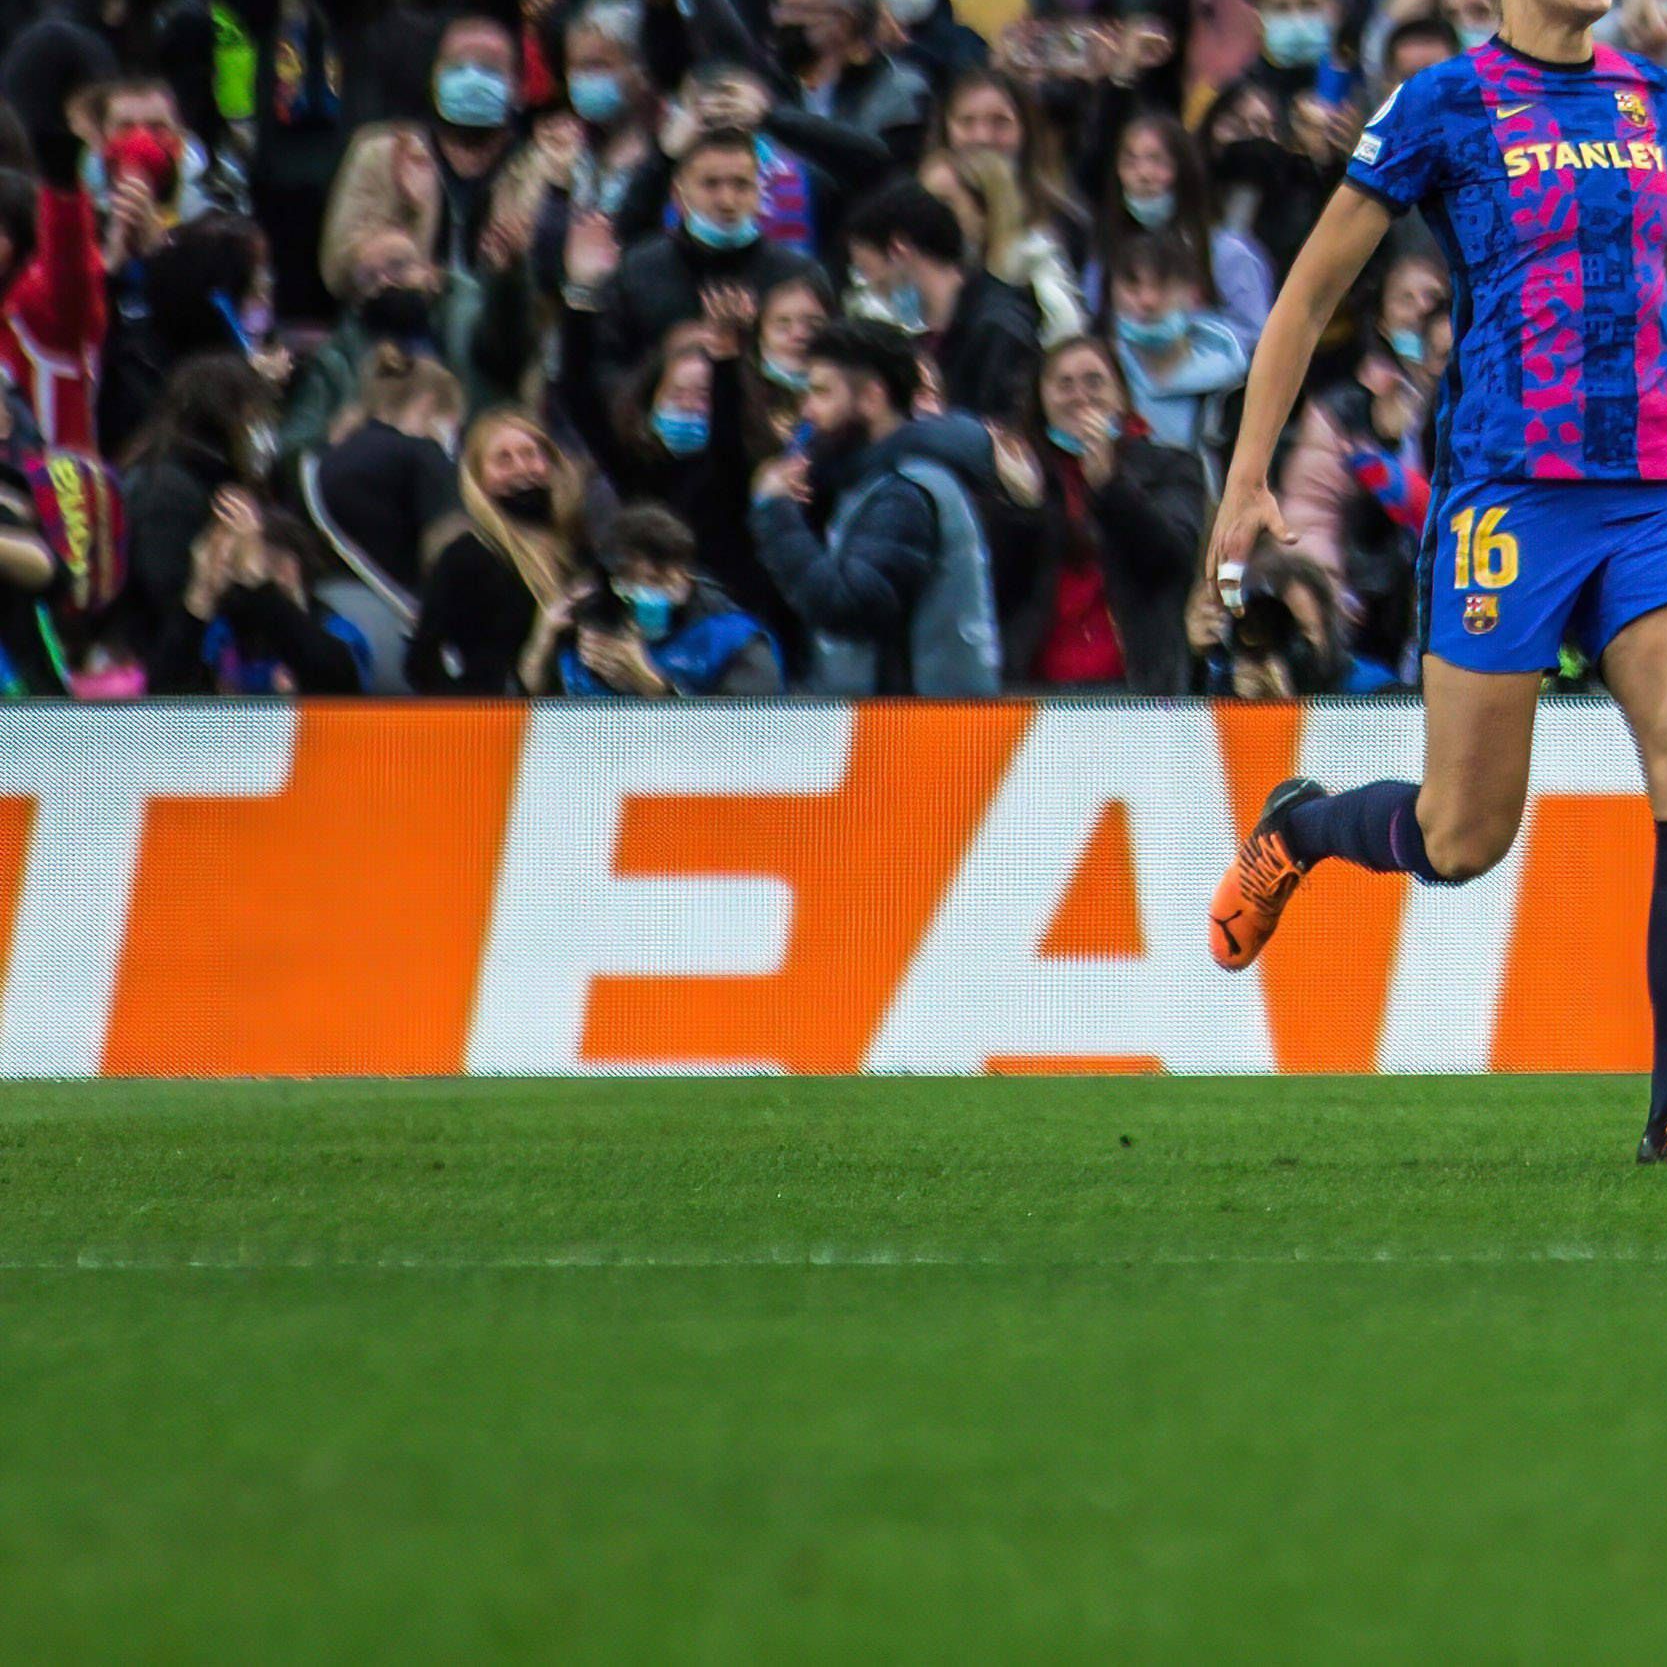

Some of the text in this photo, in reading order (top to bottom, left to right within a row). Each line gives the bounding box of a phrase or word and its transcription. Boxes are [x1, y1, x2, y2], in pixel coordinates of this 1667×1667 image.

[1503, 141, 1665, 178] STANLEY
[1449, 506, 1519, 589] 16
[462, 700, 1652, 1076] EAT
